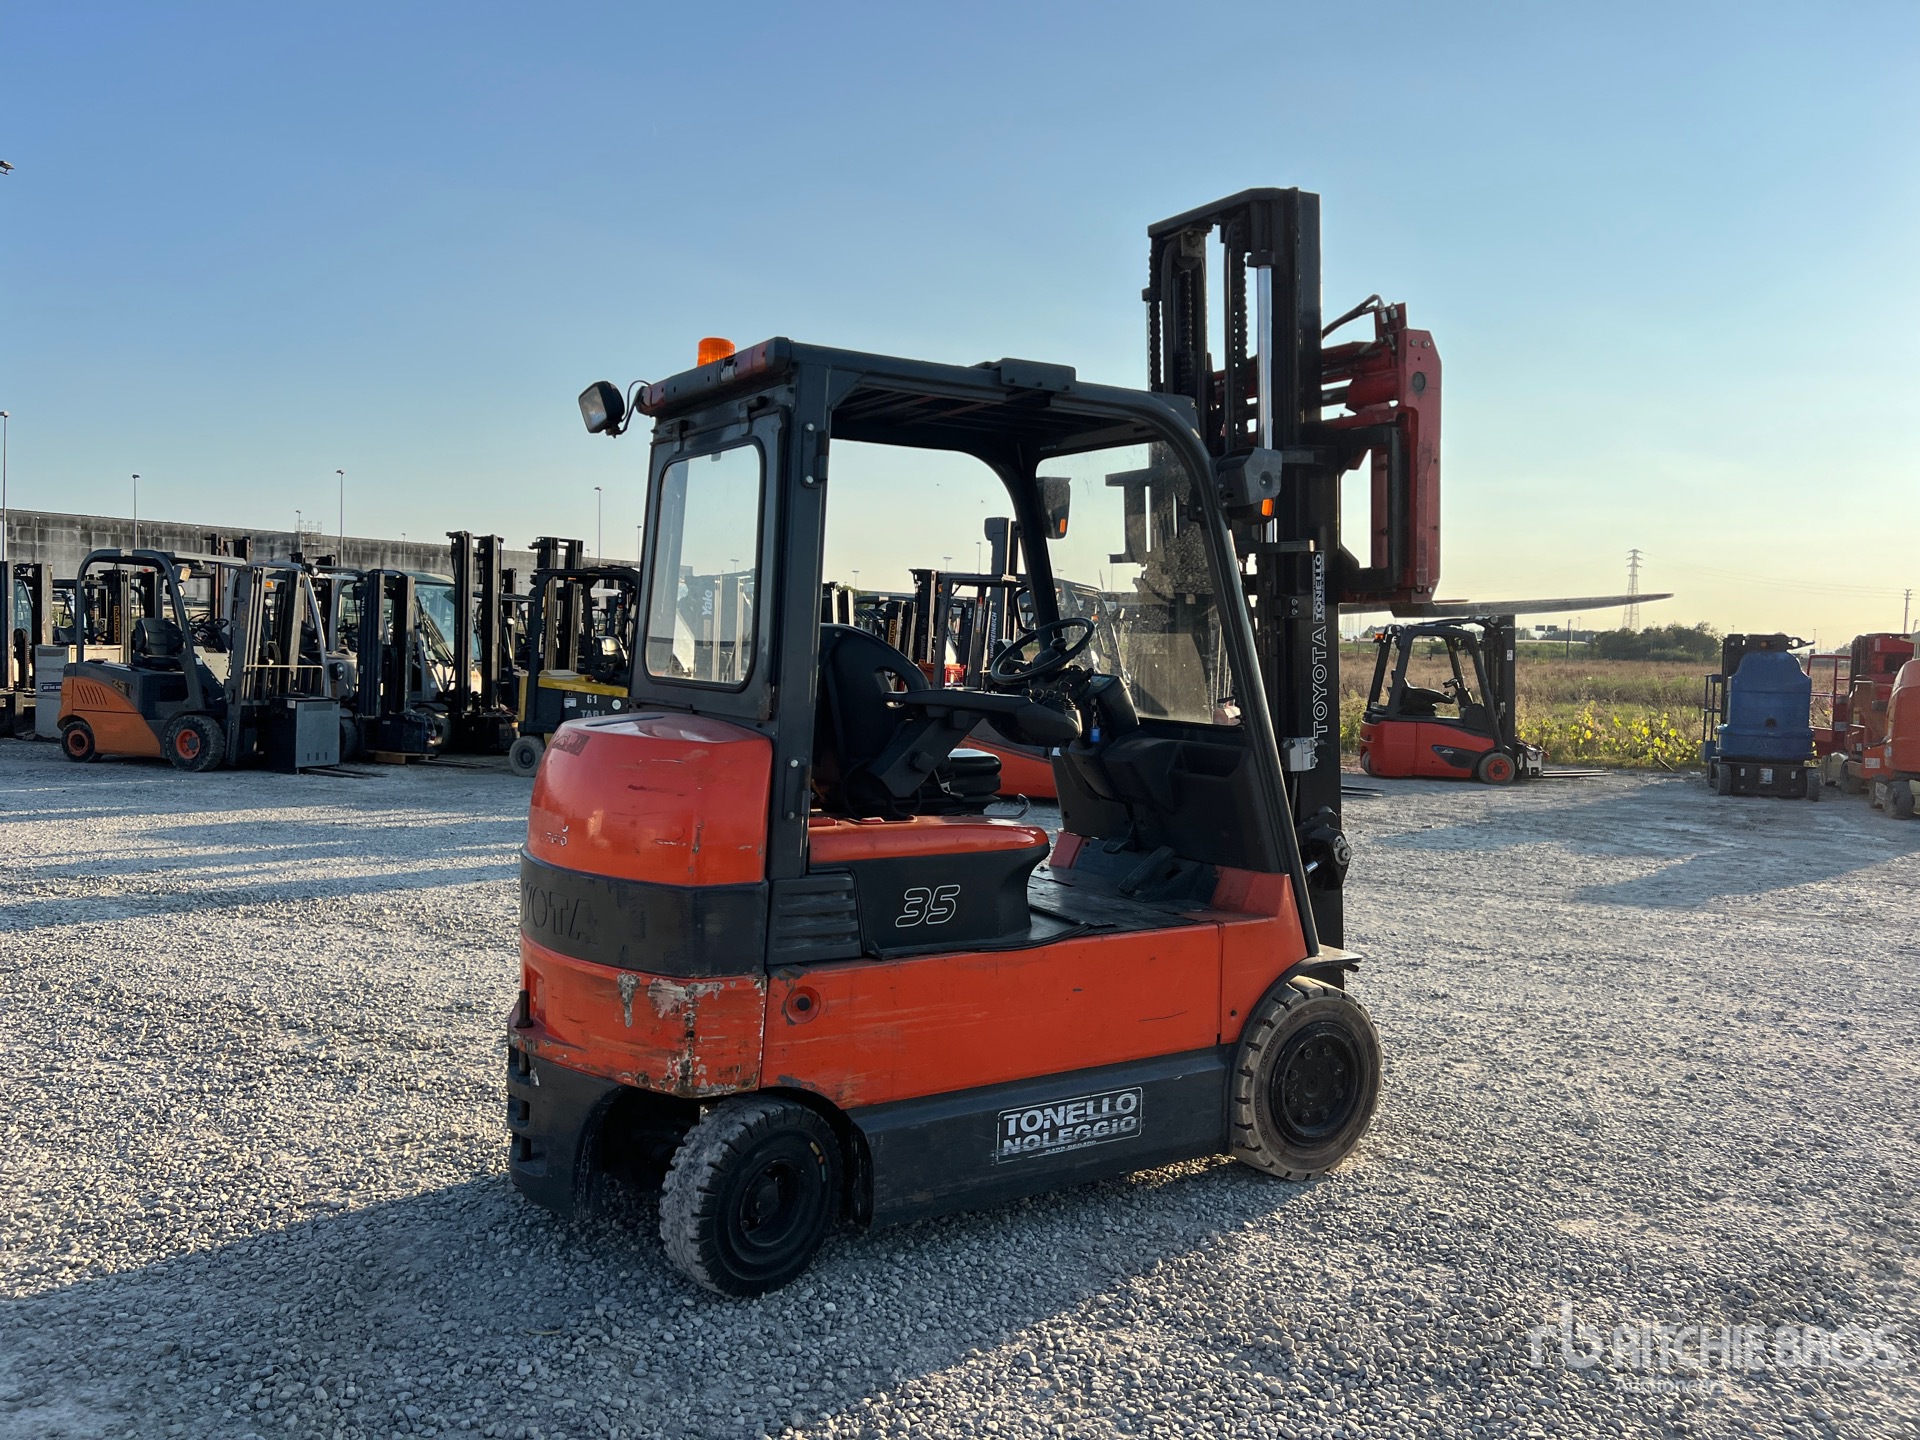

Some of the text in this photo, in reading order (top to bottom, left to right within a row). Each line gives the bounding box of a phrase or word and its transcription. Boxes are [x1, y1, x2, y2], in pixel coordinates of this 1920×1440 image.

[702, 590, 713, 615] Yale
[1314, 553, 1323, 621] TONELLO
[587, 695, 597, 704] 61
[1311, 625, 1328, 739] TOYOTA
[895, 884, 961, 928] 35
[1003, 1092, 1137, 1136] TONELLO
